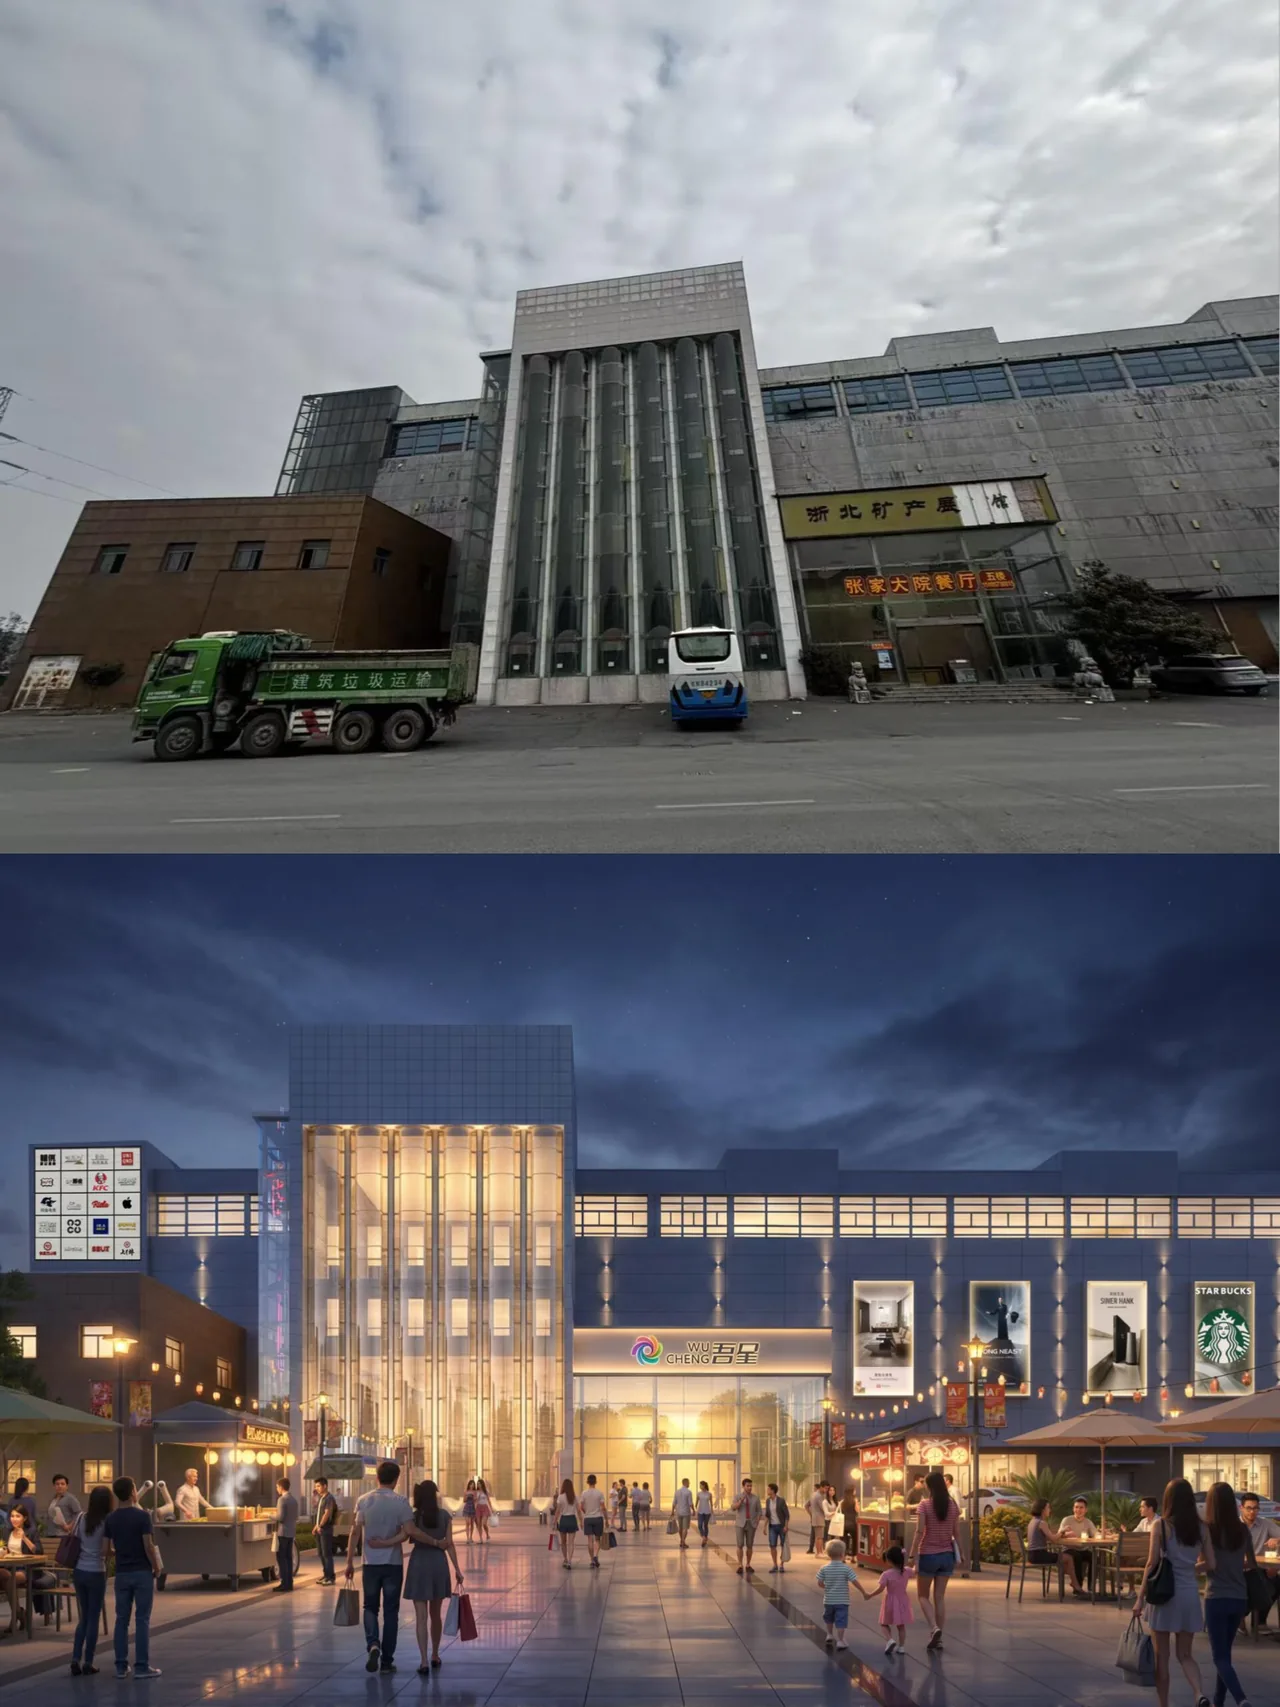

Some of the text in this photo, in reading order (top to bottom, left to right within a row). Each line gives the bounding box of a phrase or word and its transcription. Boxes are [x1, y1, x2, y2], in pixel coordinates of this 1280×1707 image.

[845, 573, 977, 594] 张家大院餐厅
[291, 671, 432, 690] 建筑垃圾运输
[687, 1342, 710, 1353] WU
[666, 1354, 710, 1365] CHENG
